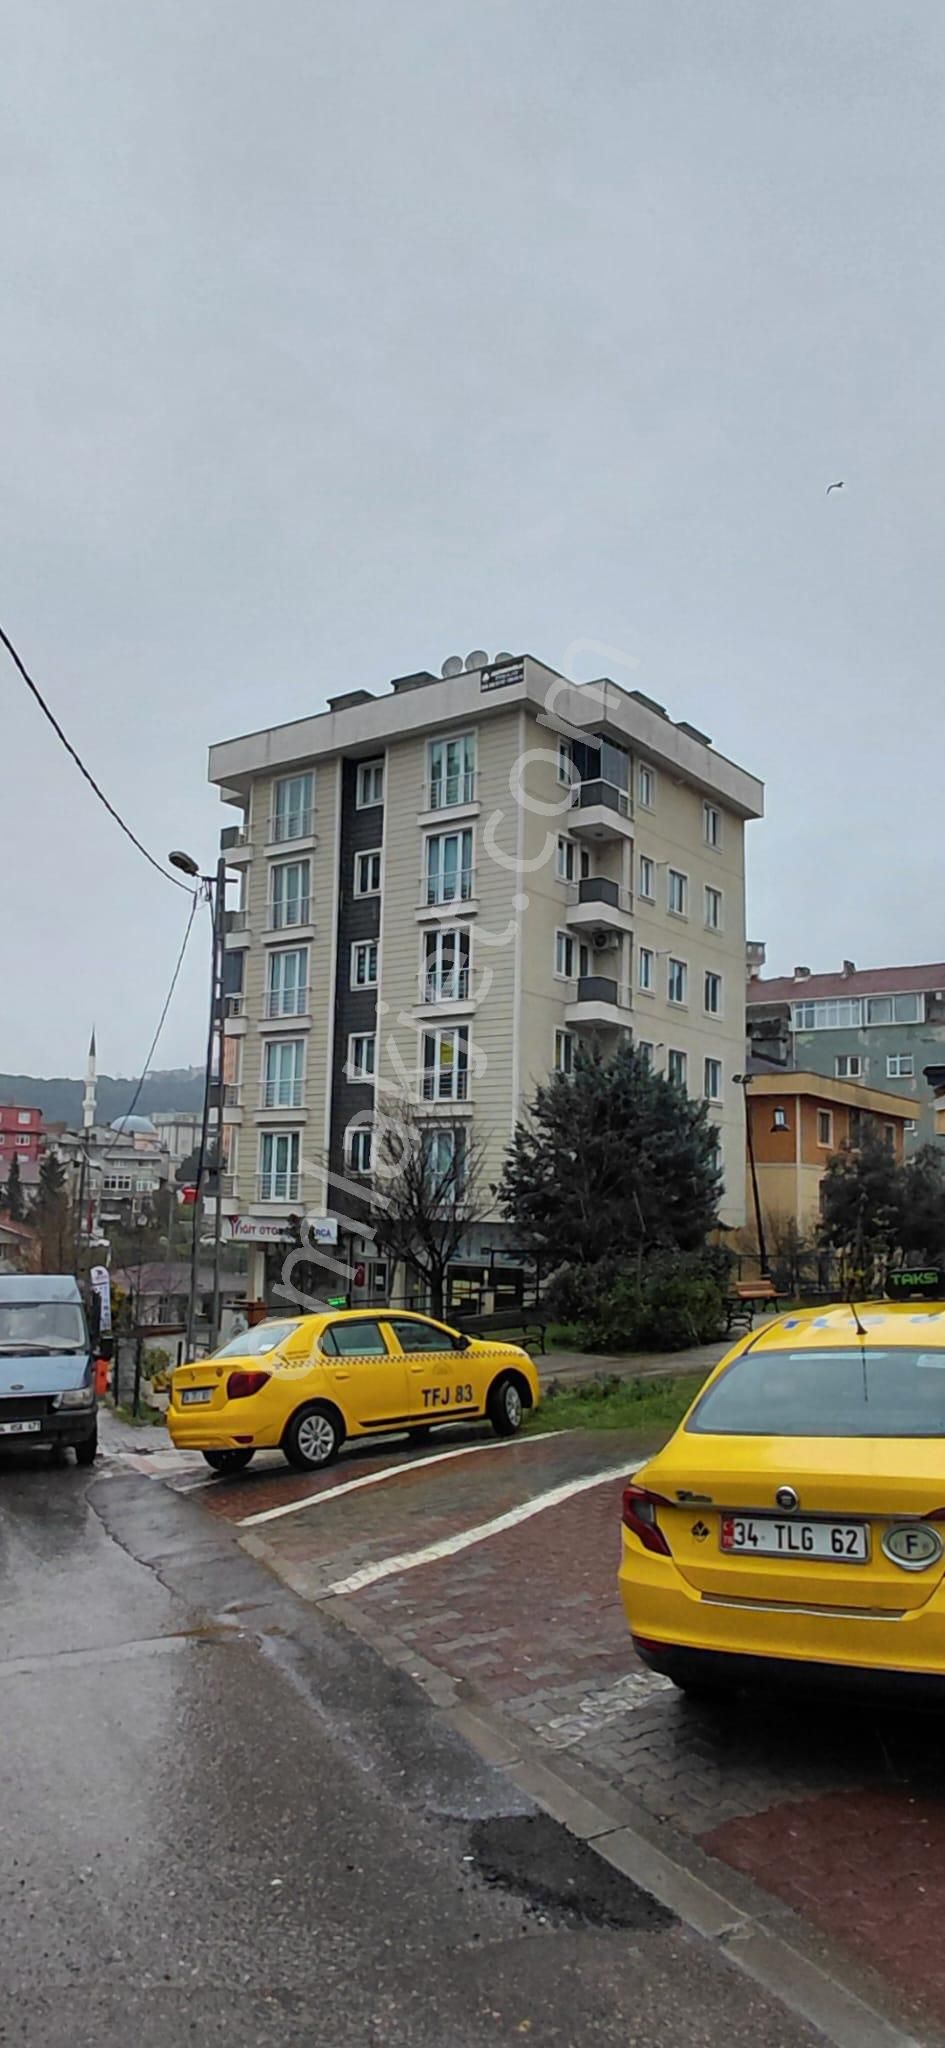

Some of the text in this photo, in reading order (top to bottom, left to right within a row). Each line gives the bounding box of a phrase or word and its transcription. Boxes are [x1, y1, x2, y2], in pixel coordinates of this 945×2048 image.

[421, 1383, 473, 1408] TFJ 83
[734, 1522, 758, 1547] 34
[774, 1524, 814, 1551] TLG
[831, 1528, 858, 1554] 62
[906, 1534, 918, 1555] F
